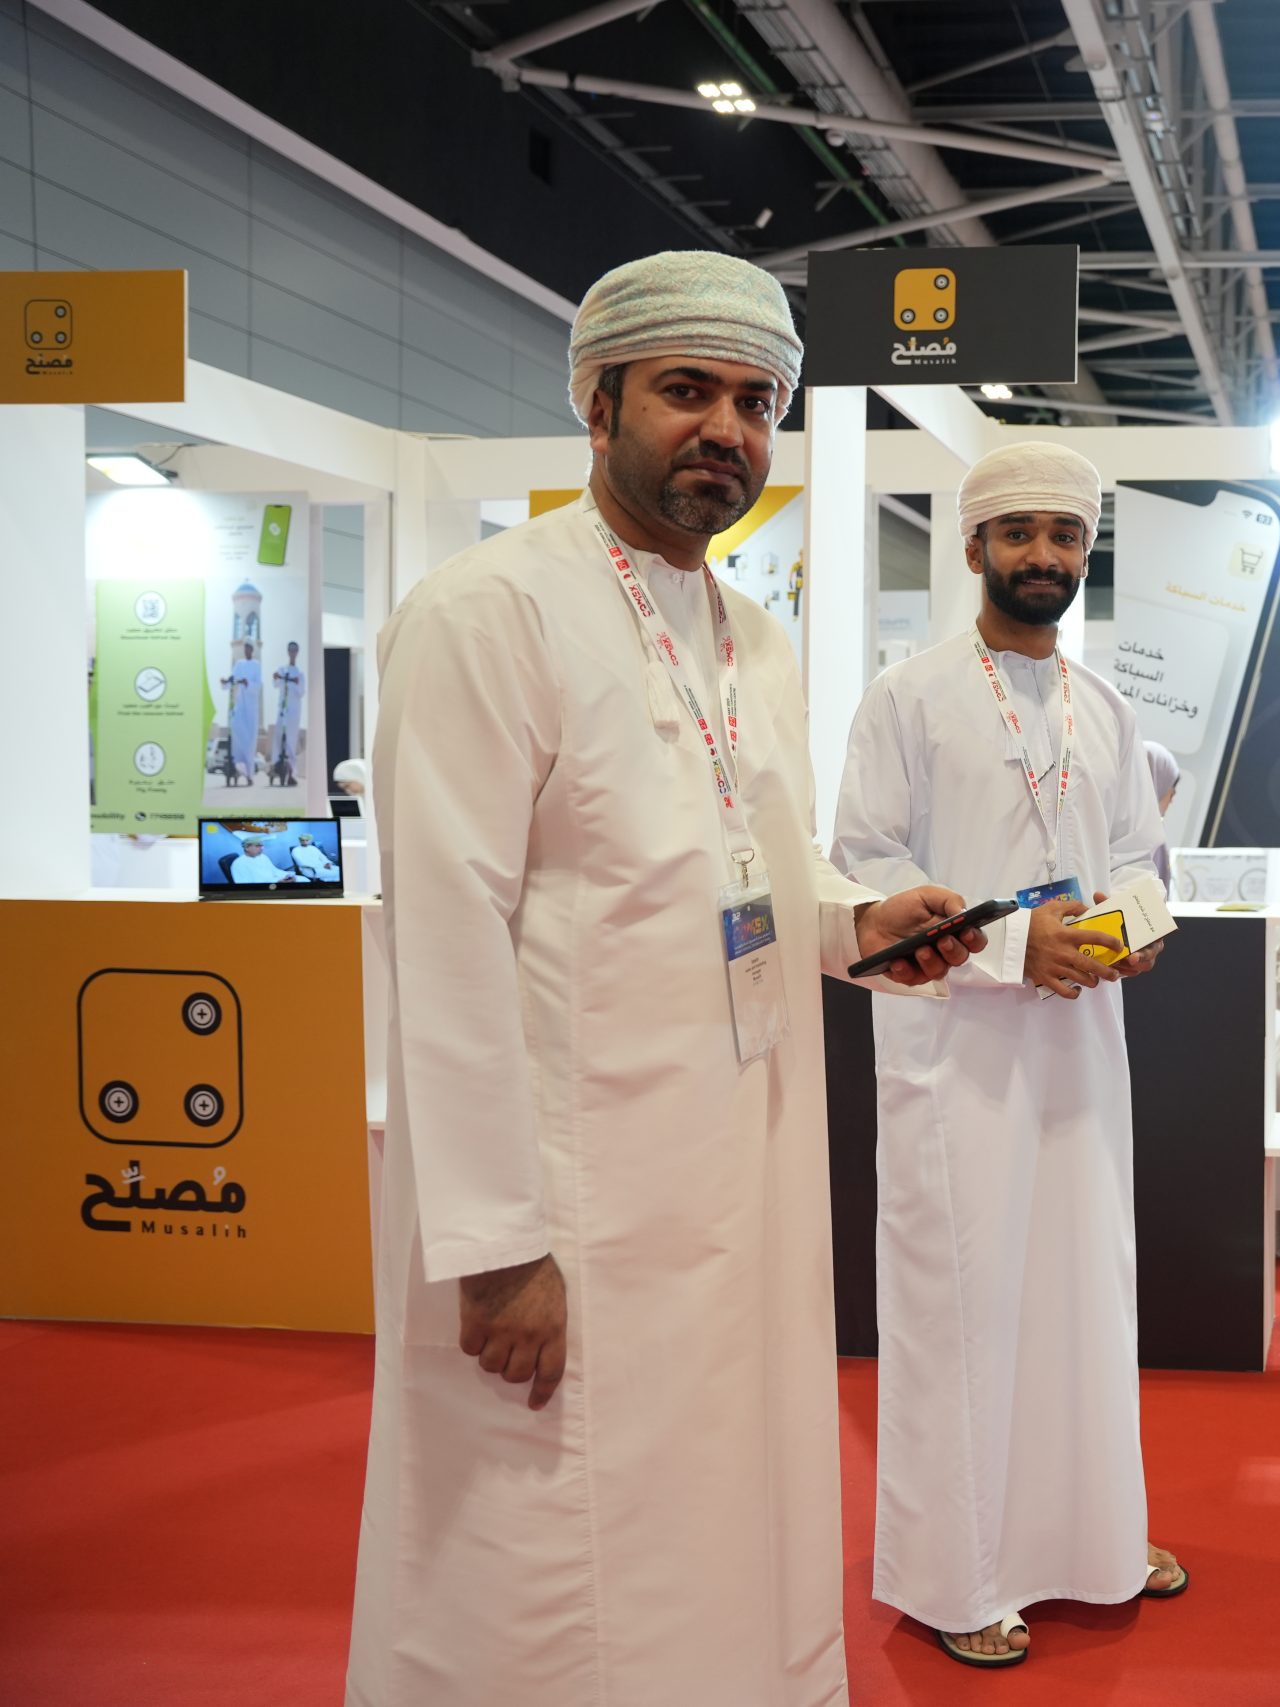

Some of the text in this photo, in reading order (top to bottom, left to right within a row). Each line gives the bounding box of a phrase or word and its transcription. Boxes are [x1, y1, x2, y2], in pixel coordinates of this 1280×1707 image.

[627, 583, 651, 618] COMEX
[661, 637, 680, 667] COMEX
[1118, 641, 1165, 661] خدمات
[1114, 658, 1165, 683] السباكة
[1142, 690, 1199, 719] وخزانات
[711, 759, 727, 794] COMEX
[141, 1221, 247, 1239] Musalih
